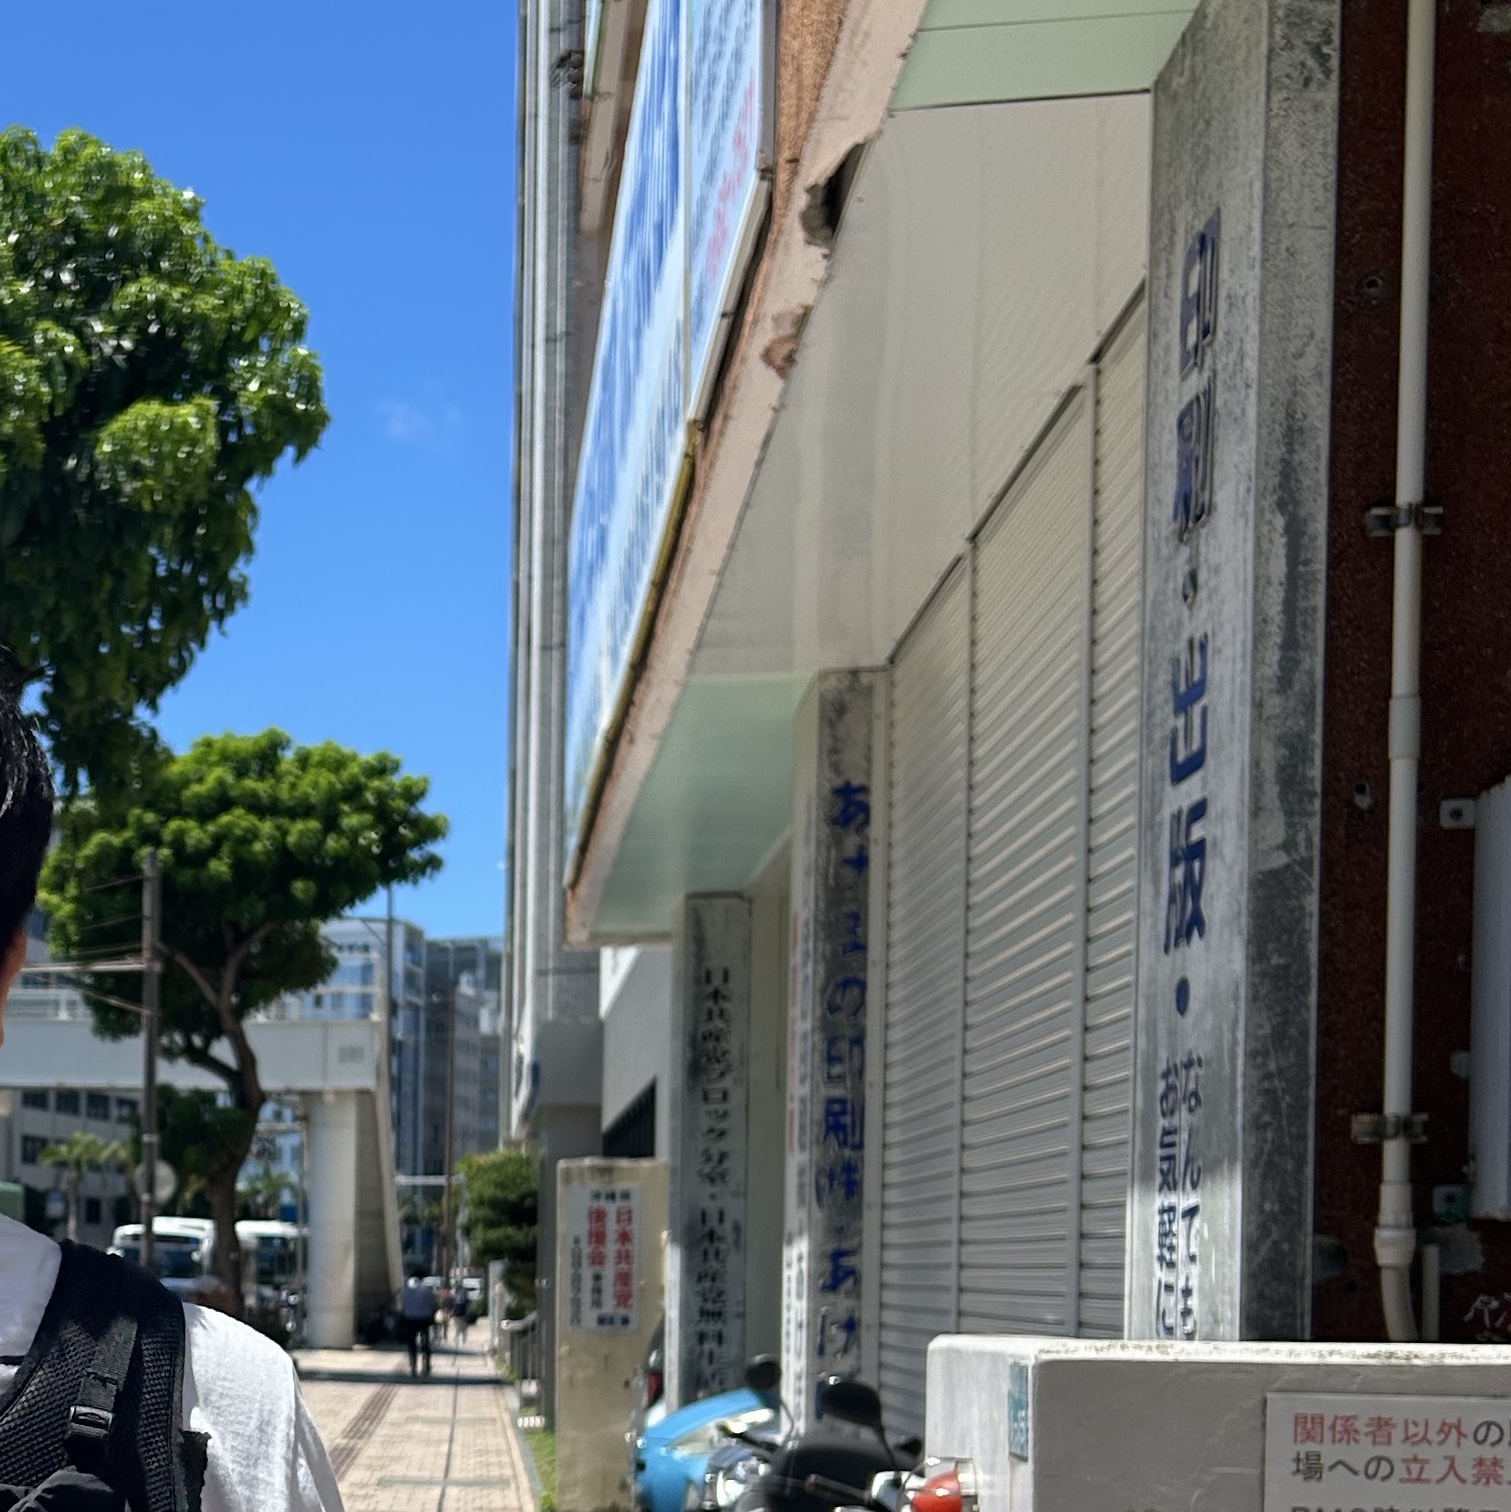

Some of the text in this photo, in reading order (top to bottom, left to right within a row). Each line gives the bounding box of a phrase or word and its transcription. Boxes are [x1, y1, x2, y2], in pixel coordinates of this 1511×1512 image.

[1293, 1412, 1511, 1448] 関係者以外の
[1291, 1450, 1511, 1487] 場への立入禁
